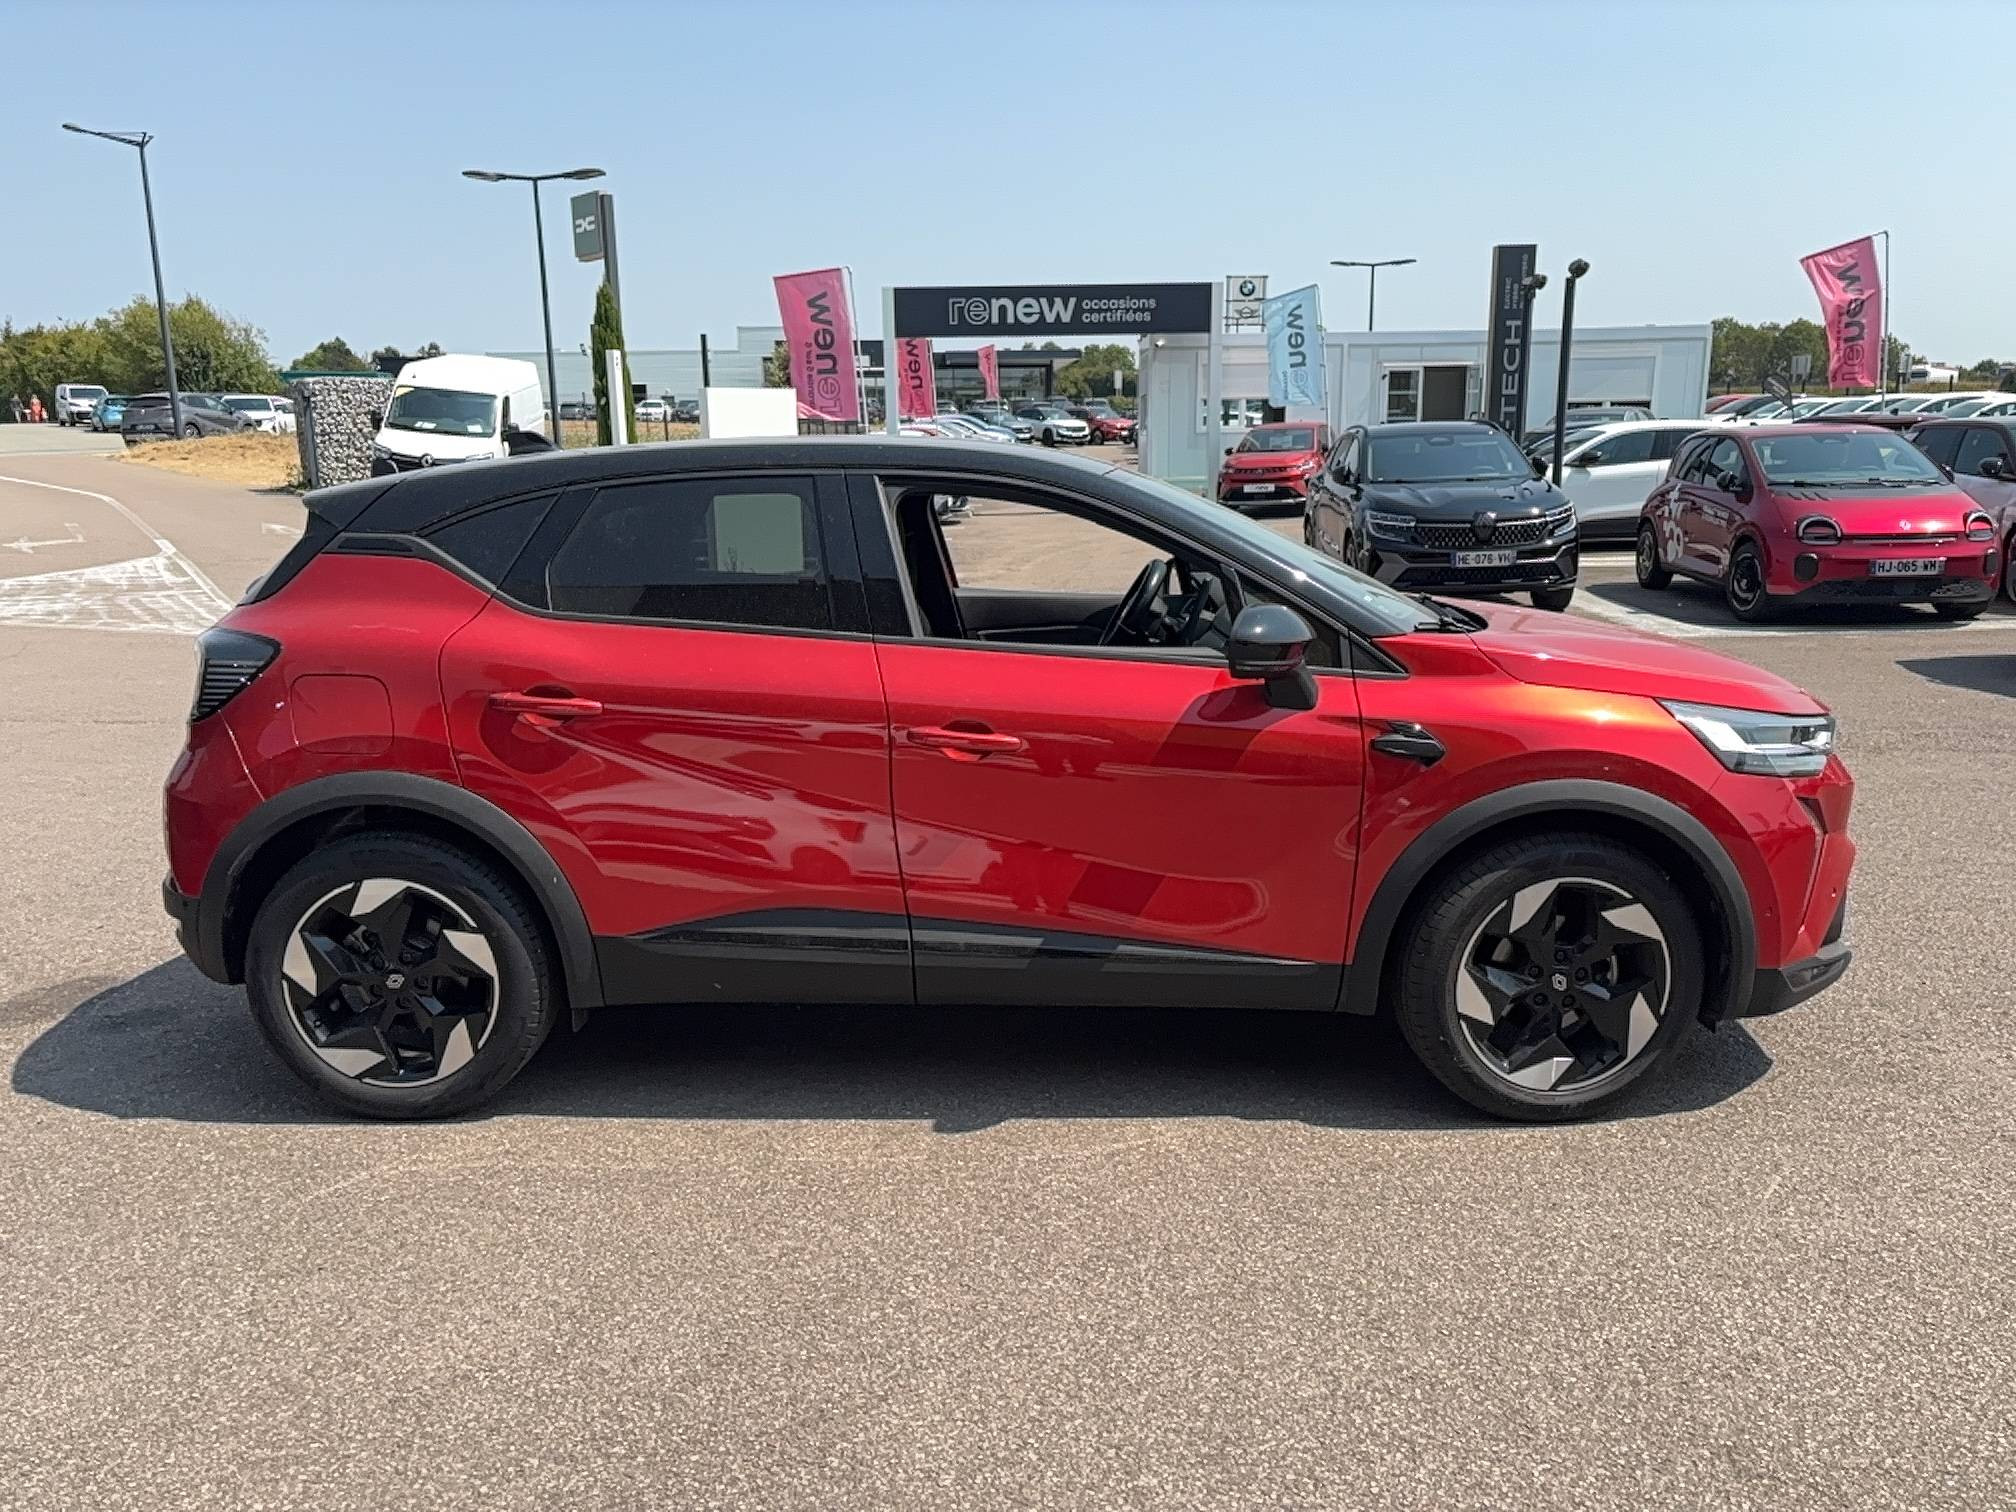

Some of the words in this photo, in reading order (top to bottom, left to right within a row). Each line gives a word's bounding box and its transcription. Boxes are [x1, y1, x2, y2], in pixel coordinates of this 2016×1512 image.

[1081, 296, 1157, 310] occasions
[949, 297, 1077, 325] renew
[1081, 309, 1152, 323] certifiées
